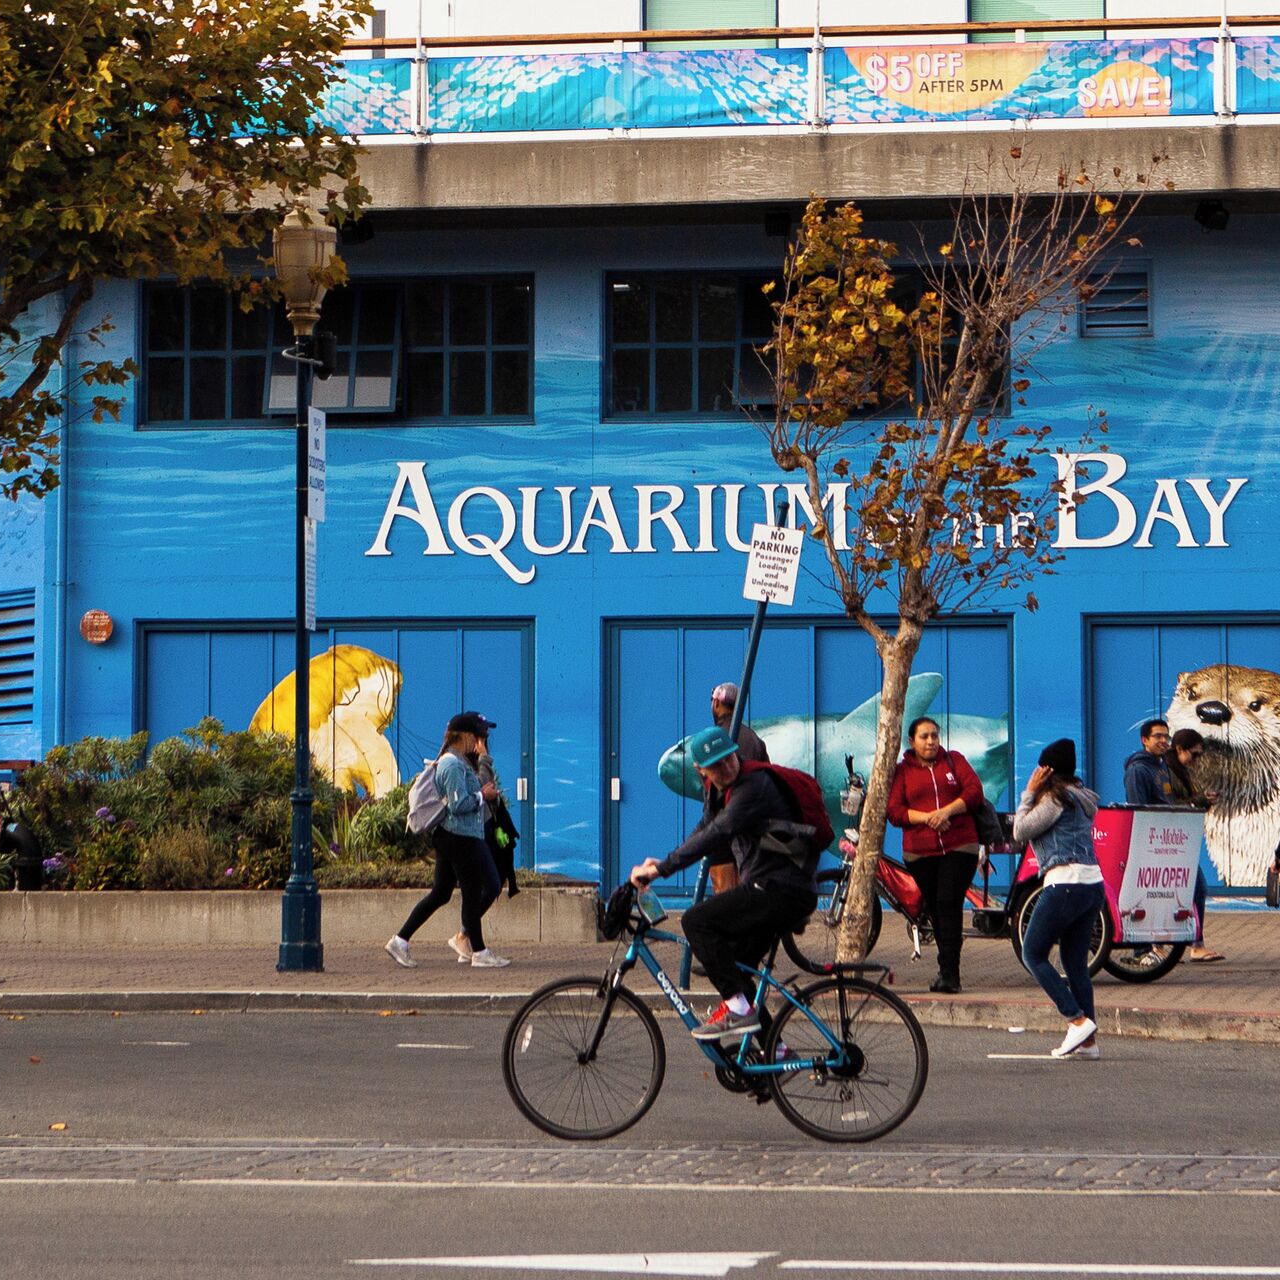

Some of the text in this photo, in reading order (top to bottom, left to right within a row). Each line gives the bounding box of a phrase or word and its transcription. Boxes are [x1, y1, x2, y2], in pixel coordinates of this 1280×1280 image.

[864, 52, 964, 96] $5 OFF
[918, 78, 1004, 94] AFTER 5PM
[1077, 76, 1173, 109] SAVE!
[364, 461, 852, 585] AQUARIUM
[1049, 452, 1249, 549] BAY
[770, 530, 786, 541] NO
[753, 540, 799, 556] PARKING
[755, 552, 793, 565] Passenger
[758, 561, 787, 574] Loading
[764, 572, 779, 580] and
[751, 578, 789, 592] Unloading
[760, 588, 777, 599] Only
[1136, 867, 1190, 889] NOW OPEN
